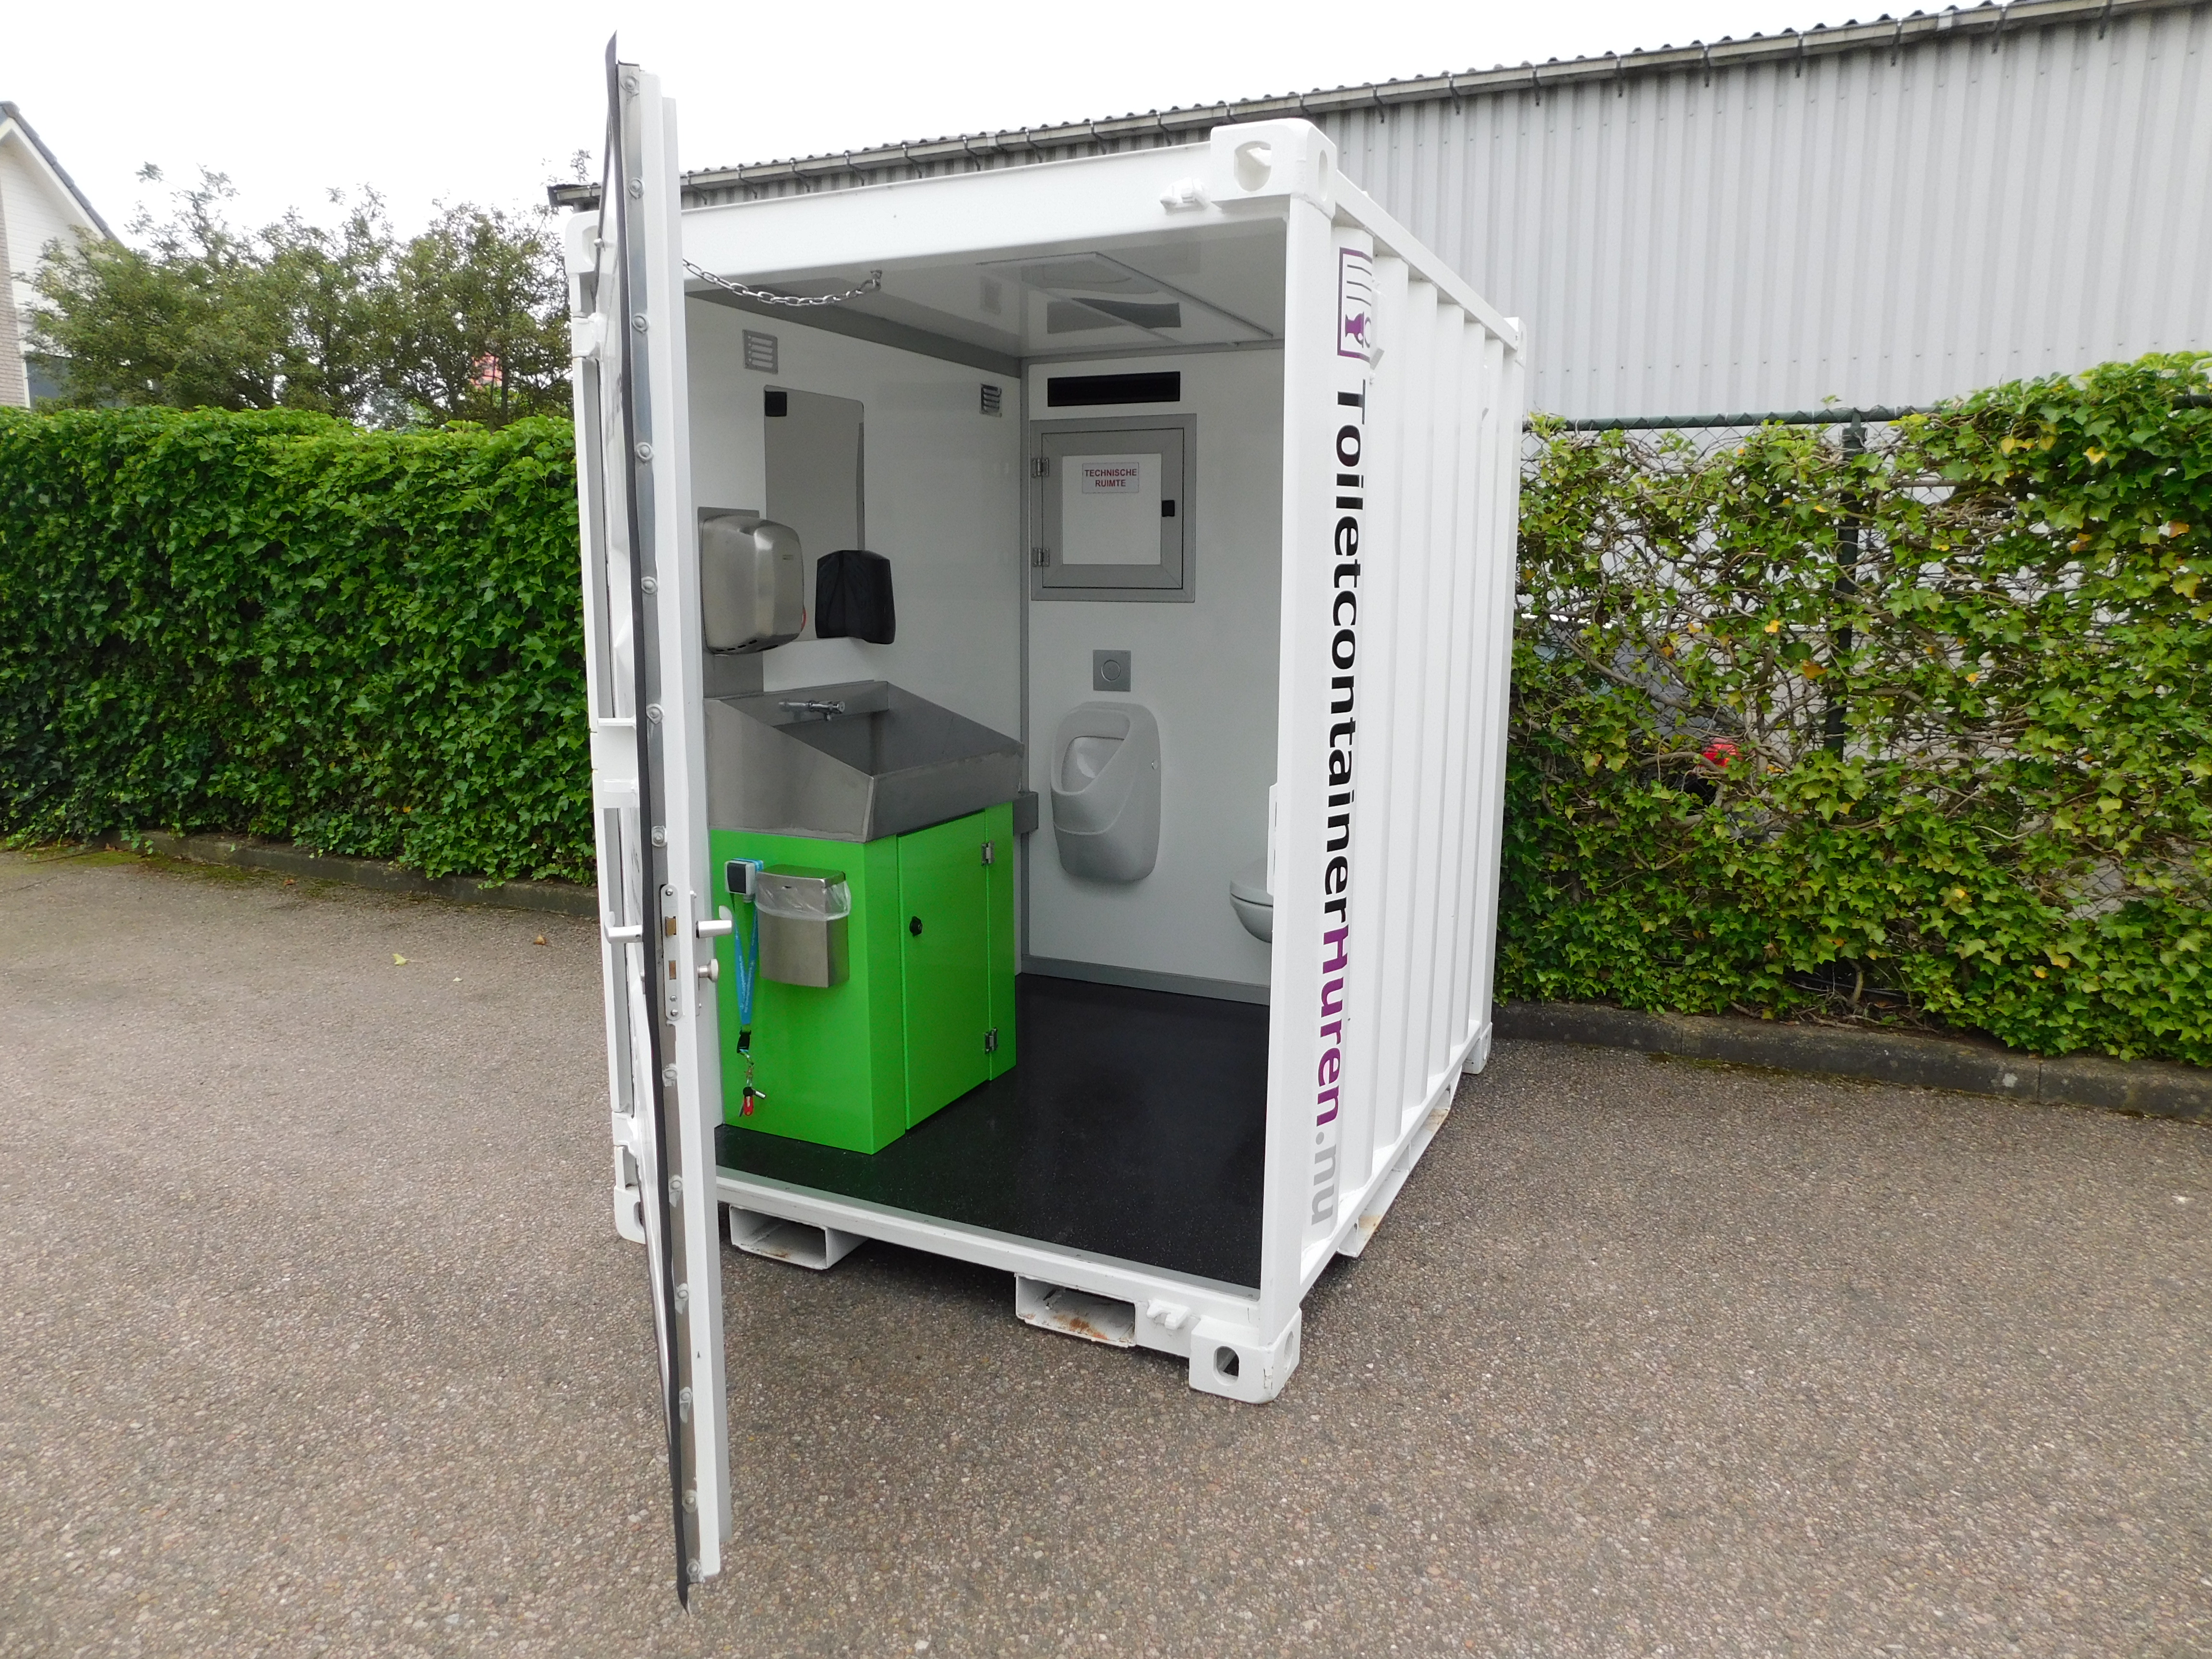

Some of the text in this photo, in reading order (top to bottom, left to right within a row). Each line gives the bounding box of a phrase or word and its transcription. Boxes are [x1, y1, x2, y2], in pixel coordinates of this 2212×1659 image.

[1084, 469, 1137, 477] TECHNISCHE
[1095, 479, 1126, 487] RUIMTE
[1311, 379, 1365, 1225] ToiletcontainerHuren.nu
